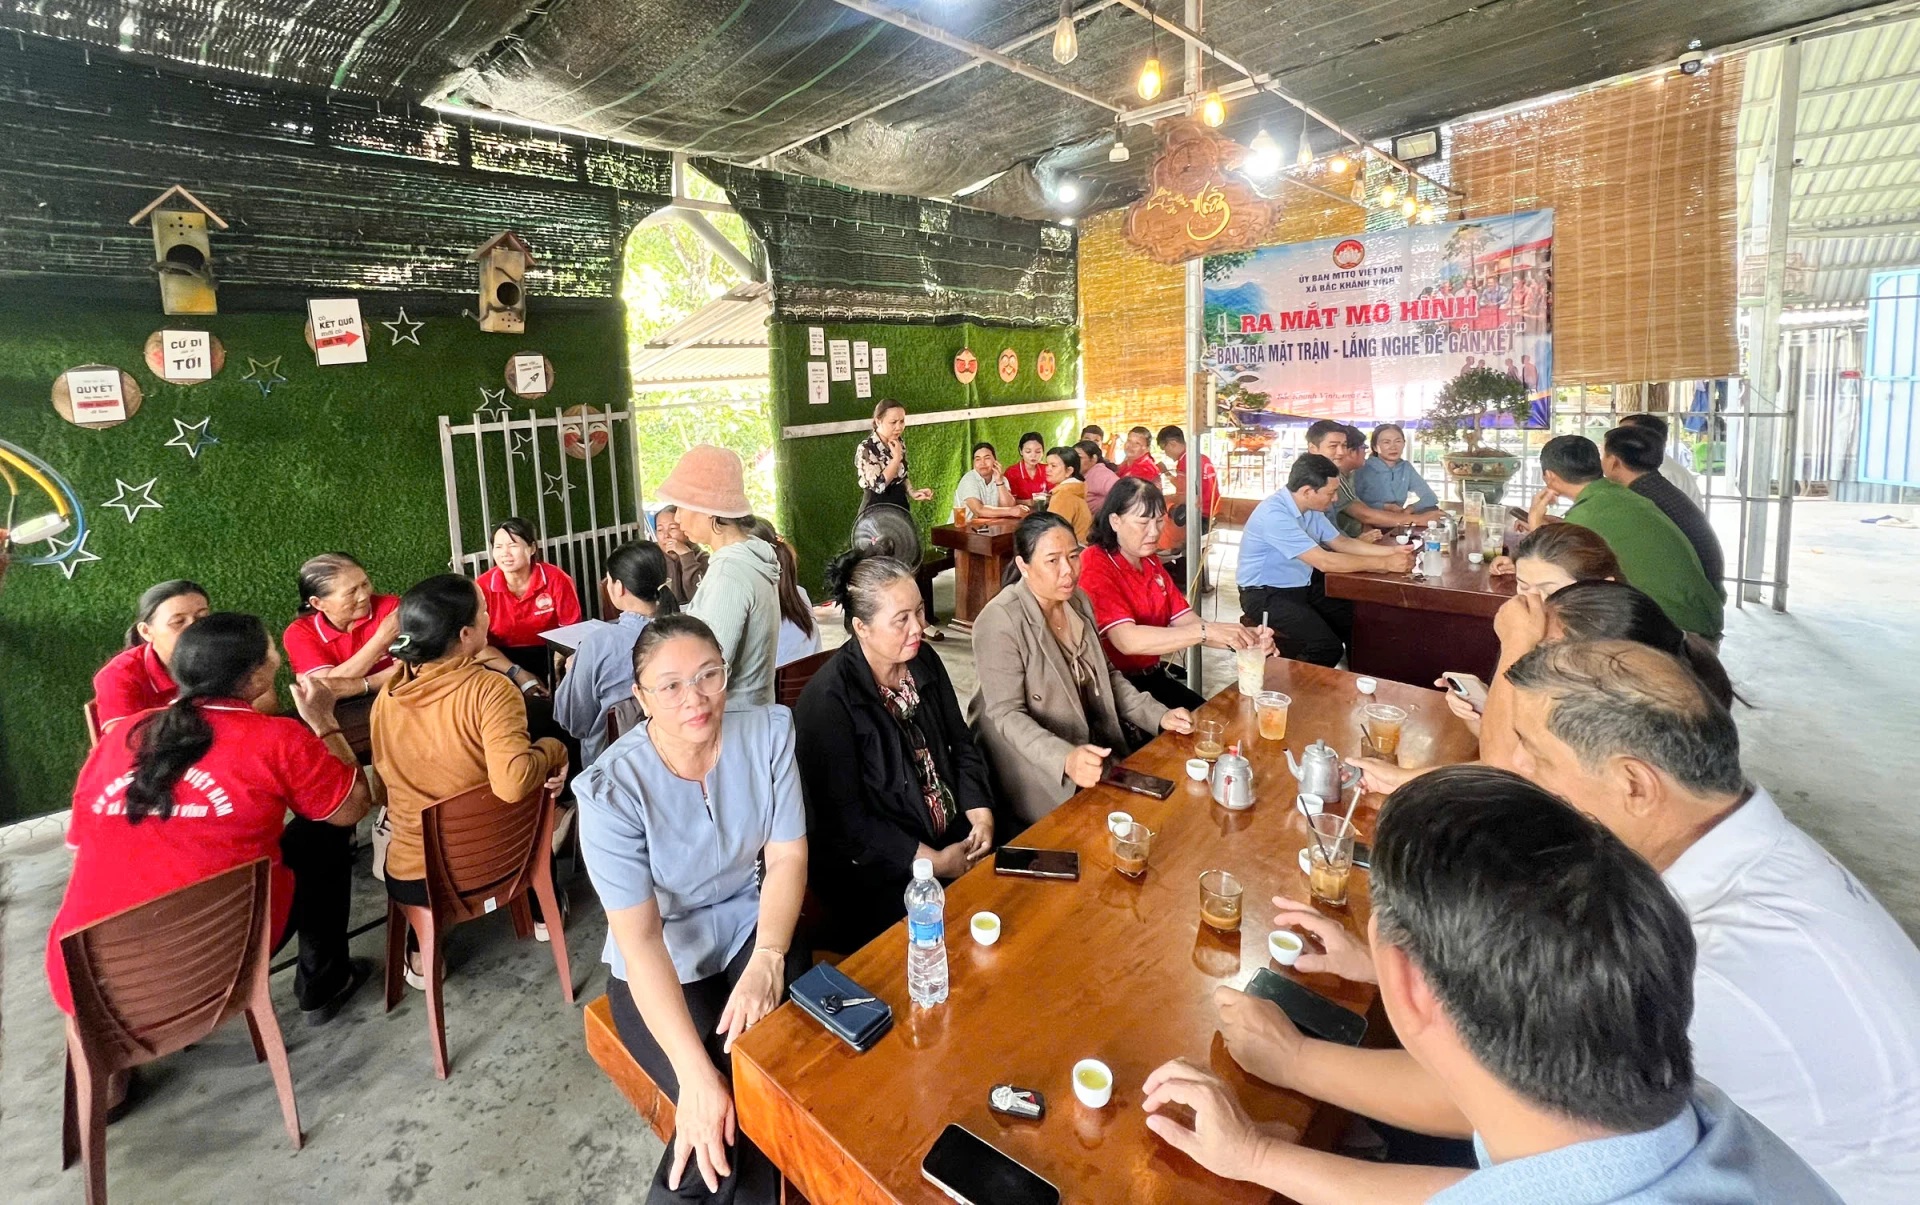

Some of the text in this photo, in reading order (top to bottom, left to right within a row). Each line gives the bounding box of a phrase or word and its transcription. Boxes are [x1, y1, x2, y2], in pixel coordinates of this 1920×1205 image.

[1312, 274, 1329, 282] BAN
[1333, 270, 1355, 279] MTTQ
[1359, 267, 1377, 277] VIỆT
[1381, 265, 1403, 275] NAM
[1339, 278, 1370, 290] KHÁNH
[1241, 294, 1478, 333] RA MẮT MÔ HÌNH
[1268, 340, 1293, 366] MẶT
[1297, 338, 1329, 364] TRẬN
[1342, 331, 1377, 359] LẮNG
[1381, 335, 1419, 357] NGHE
[1424, 325, 1446, 354] ĐỂ
[1449, 324, 1482, 353] GẮN
[206, 786, 234, 817] NAM
